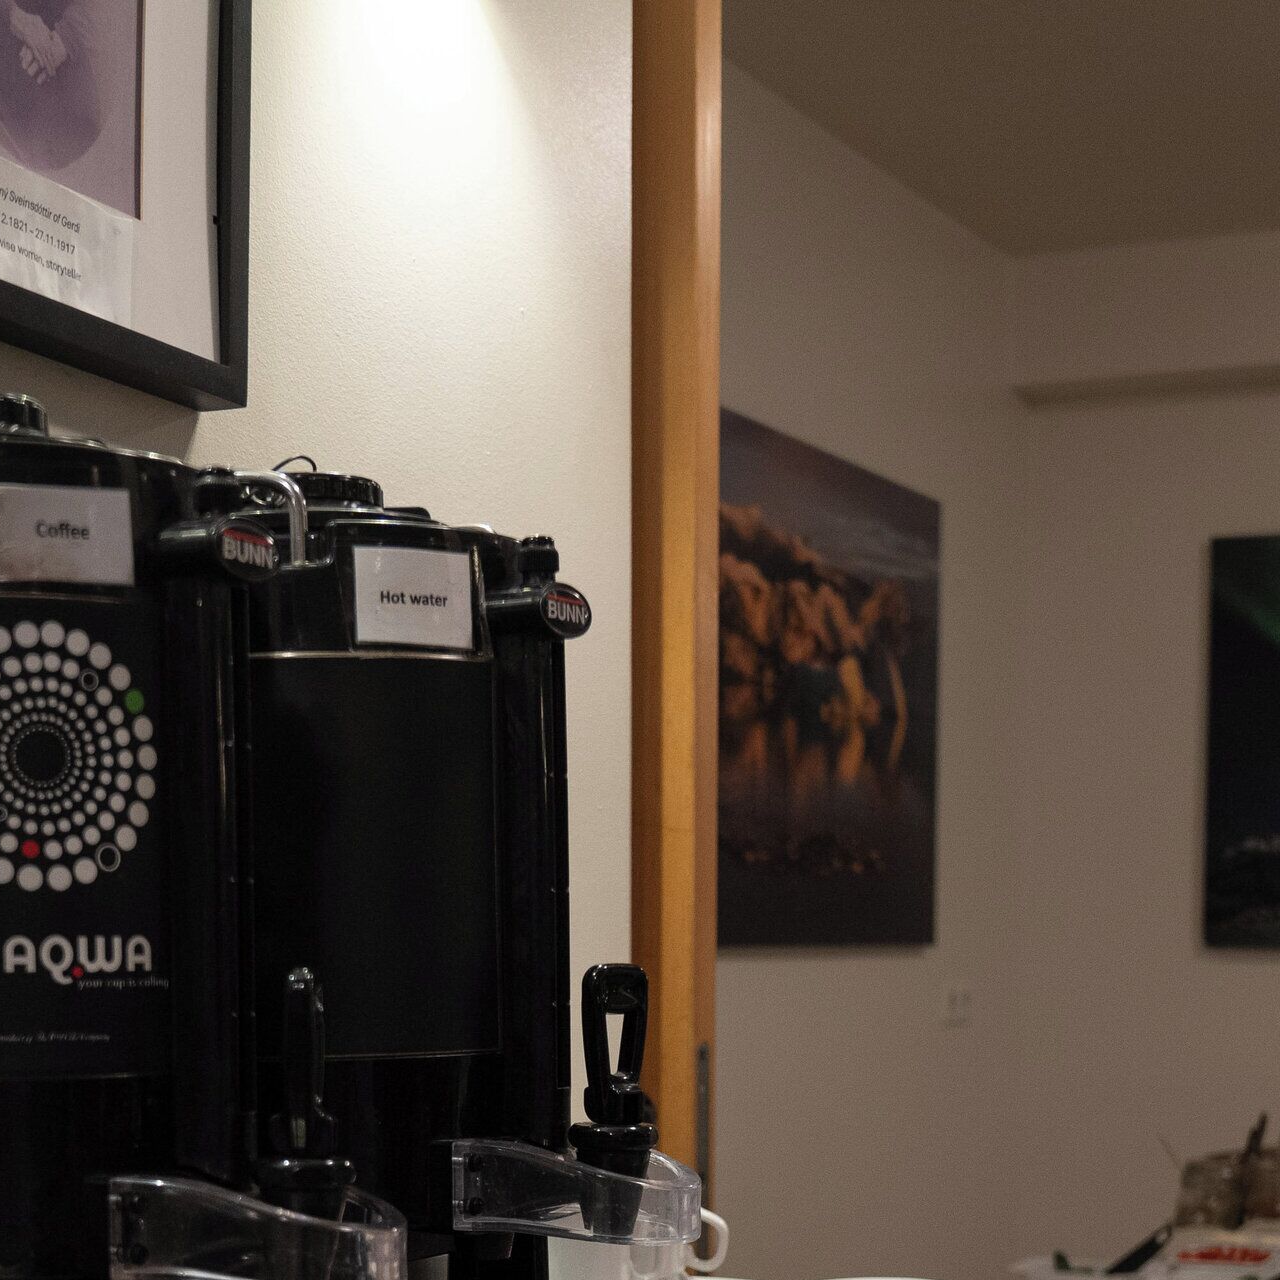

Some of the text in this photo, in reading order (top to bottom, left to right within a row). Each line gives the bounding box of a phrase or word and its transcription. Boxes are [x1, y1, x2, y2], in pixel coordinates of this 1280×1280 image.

[9, 190, 52, 219] Sveinsdóttir
[53, 213, 61, 224] of
[35, 228, 75, 255] 27.11.1917
[36, 520, 90, 541] Coffee
[223, 535, 273, 570] BUNN
[380, 590, 448, 608] Hot water
[547, 599, 585, 625] BUNN
